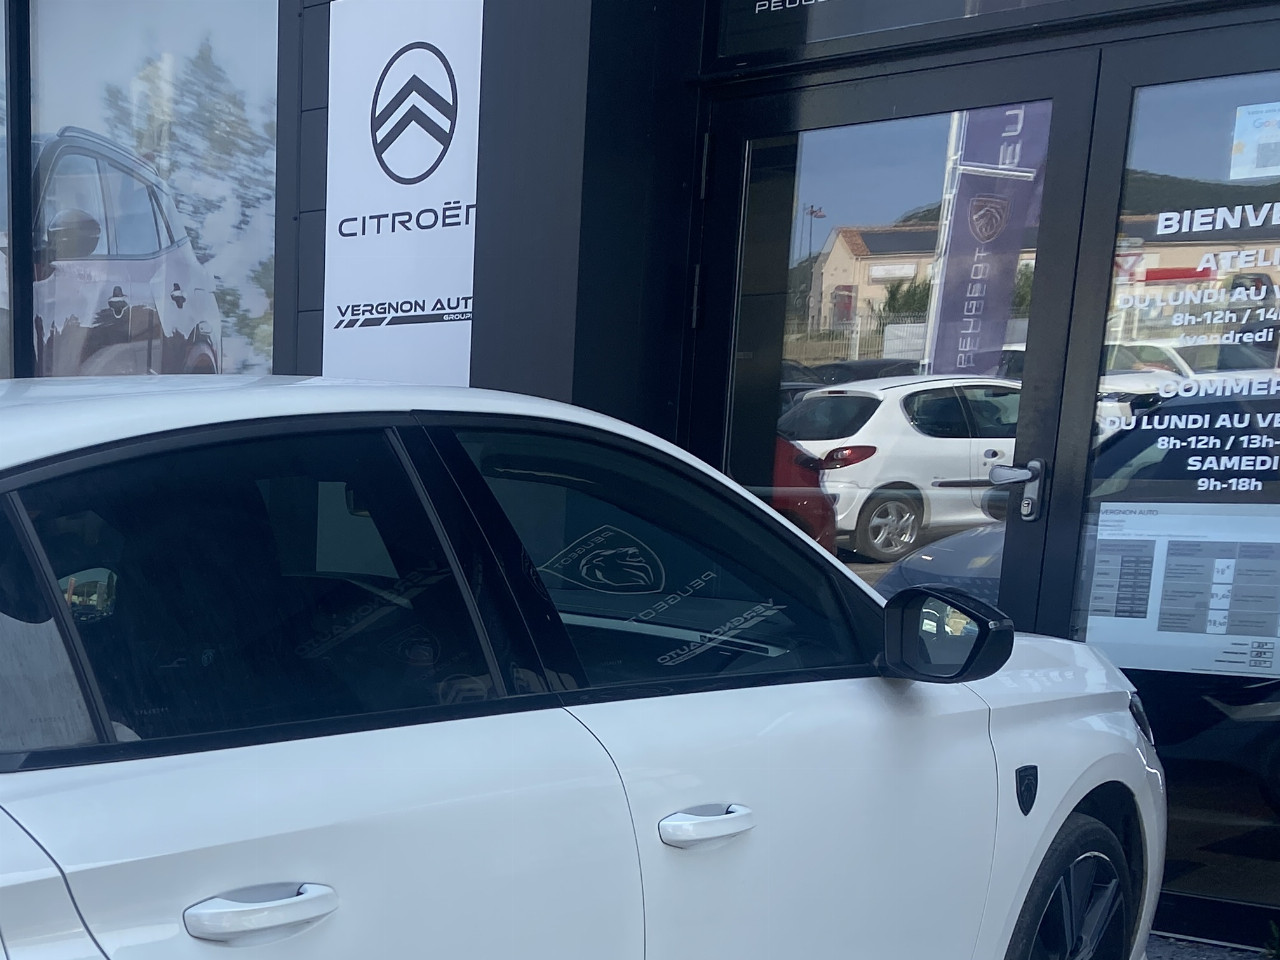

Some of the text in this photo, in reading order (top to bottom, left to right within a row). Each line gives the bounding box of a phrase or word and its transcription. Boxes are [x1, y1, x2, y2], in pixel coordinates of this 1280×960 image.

[1118, 293, 1150, 309] DU
[1156, 287, 1226, 307] LUNDI
[1230, 285, 1267, 301] AU
[336, 299, 426, 317] VERGNON
[956, 247, 990, 368] PEUGEOT
[443, 313, 473, 321] GROUP
[1172, 310, 1237, 326] 8h-12h
[1256, 307, 1280, 321] 14
[1105, 415, 1137, 430] DU
[1141, 414, 1211, 430] LUNDI
[1215, 413, 1251, 429] AU
[1156, 435, 1221, 450] 8h-12h
[1187, 455, 1280, 471] SAMEDI
[1197, 477, 1263, 491] 9h-18h
